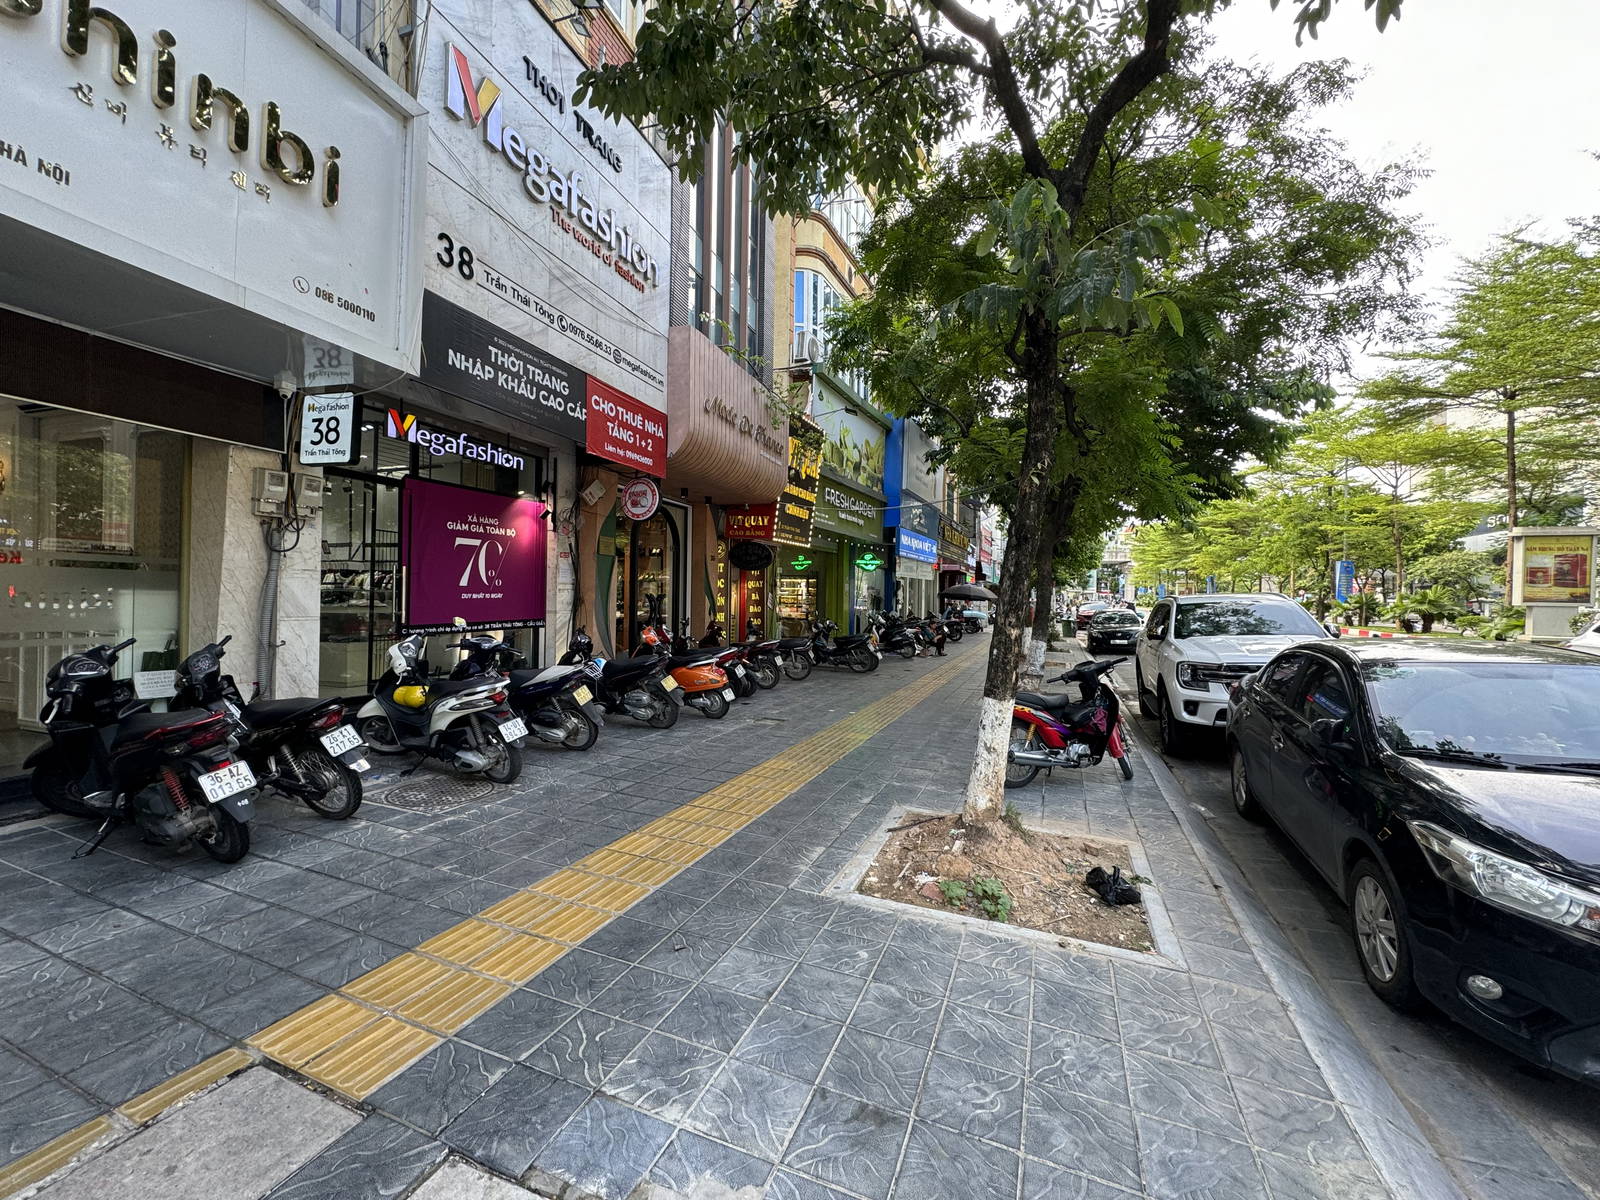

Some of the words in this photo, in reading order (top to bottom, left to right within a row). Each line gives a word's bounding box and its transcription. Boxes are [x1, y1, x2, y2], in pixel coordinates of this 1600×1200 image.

[0, 0, 342, 208] hinbi
[37, 157, 71, 187] NỘI
[443, 40, 660, 288] Megafashion
[436, 232, 475, 281] 38
[484, 268, 508, 295] Trần
[511, 286, 531, 309] Thái
[614, 259, 645, 294] fashion
[315, 286, 334, 304] 086
[337, 296, 376, 322] 5000110
[447, 348, 495, 383] NHẬP
[497, 370, 537, 401] KHẨU
[539, 390, 564, 412] CAO
[488, 345, 524, 376] THỜI
[526, 363, 570, 396] TRANG
[309, 416, 341, 446] 38
[591, 394, 616, 418] CHO
[616, 405, 644, 430] THUÊ
[644, 418, 665, 439] NHÀ
[387, 407, 525, 472] Megafashion
[606, 420, 635, 444] TẦNG
[635, 434, 640, 447] 1
[647, 438, 653, 452] 2
[825, 487, 850, 509] FRESH
[446, 520, 469, 531] GIẢM
[470, 524, 485, 533] GIÁ
[485, 526, 505, 536] TOÀN
[506, 527, 516, 538] BỘ
[479, 515, 499, 526] HÀNG
[744, 515, 770, 528] QUAY
[453, 537, 511, 590] 70%
[325, 727, 350, 745] 26-K1
[206, 764, 244, 787] 36-AZ
[208, 774, 253, 800] 013.65
